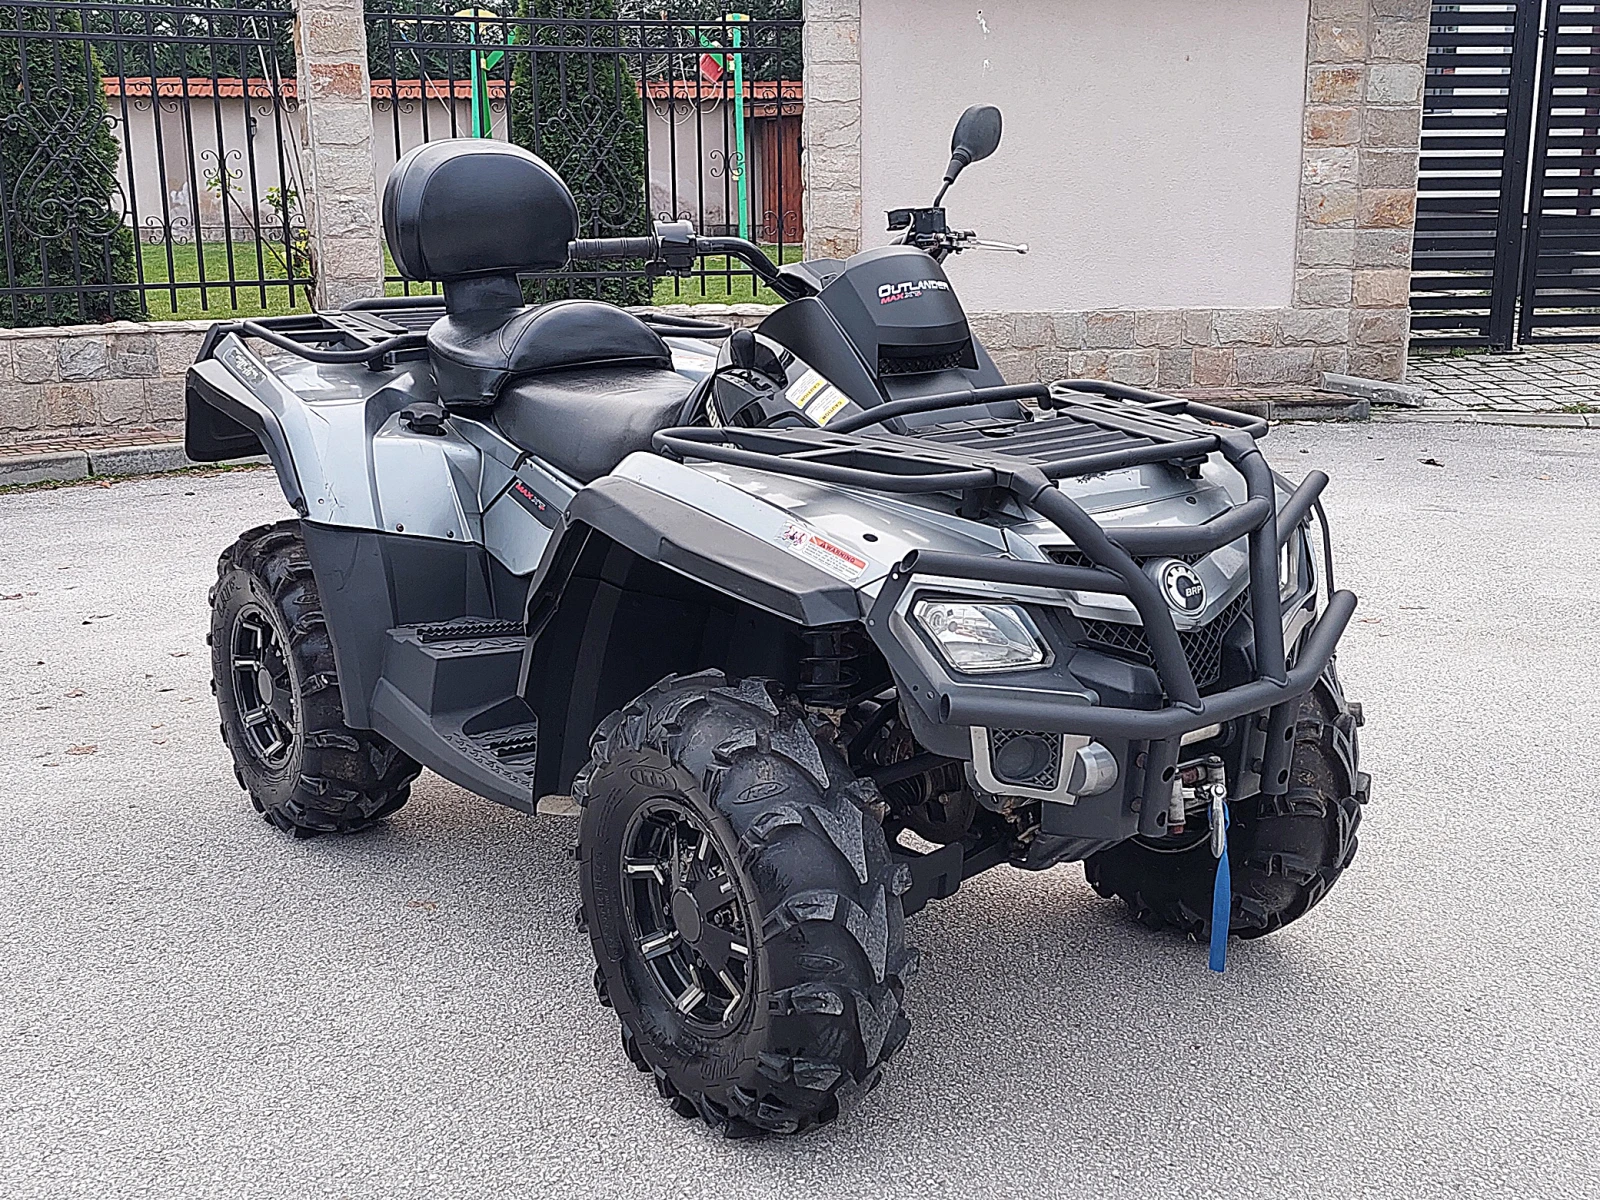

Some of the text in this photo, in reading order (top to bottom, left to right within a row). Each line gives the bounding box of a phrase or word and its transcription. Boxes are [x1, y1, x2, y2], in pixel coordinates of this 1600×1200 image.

[878, 280, 950, 298] OUTLANDER
[880, 292, 904, 304] MAX
[800, 382, 821, 403] CAUTION
[821, 400, 843, 421] CAUTION
[515, 484, 534, 500] MAX
[825, 543, 856, 564] WARNING
[1185, 586, 1202, 597] BRP
